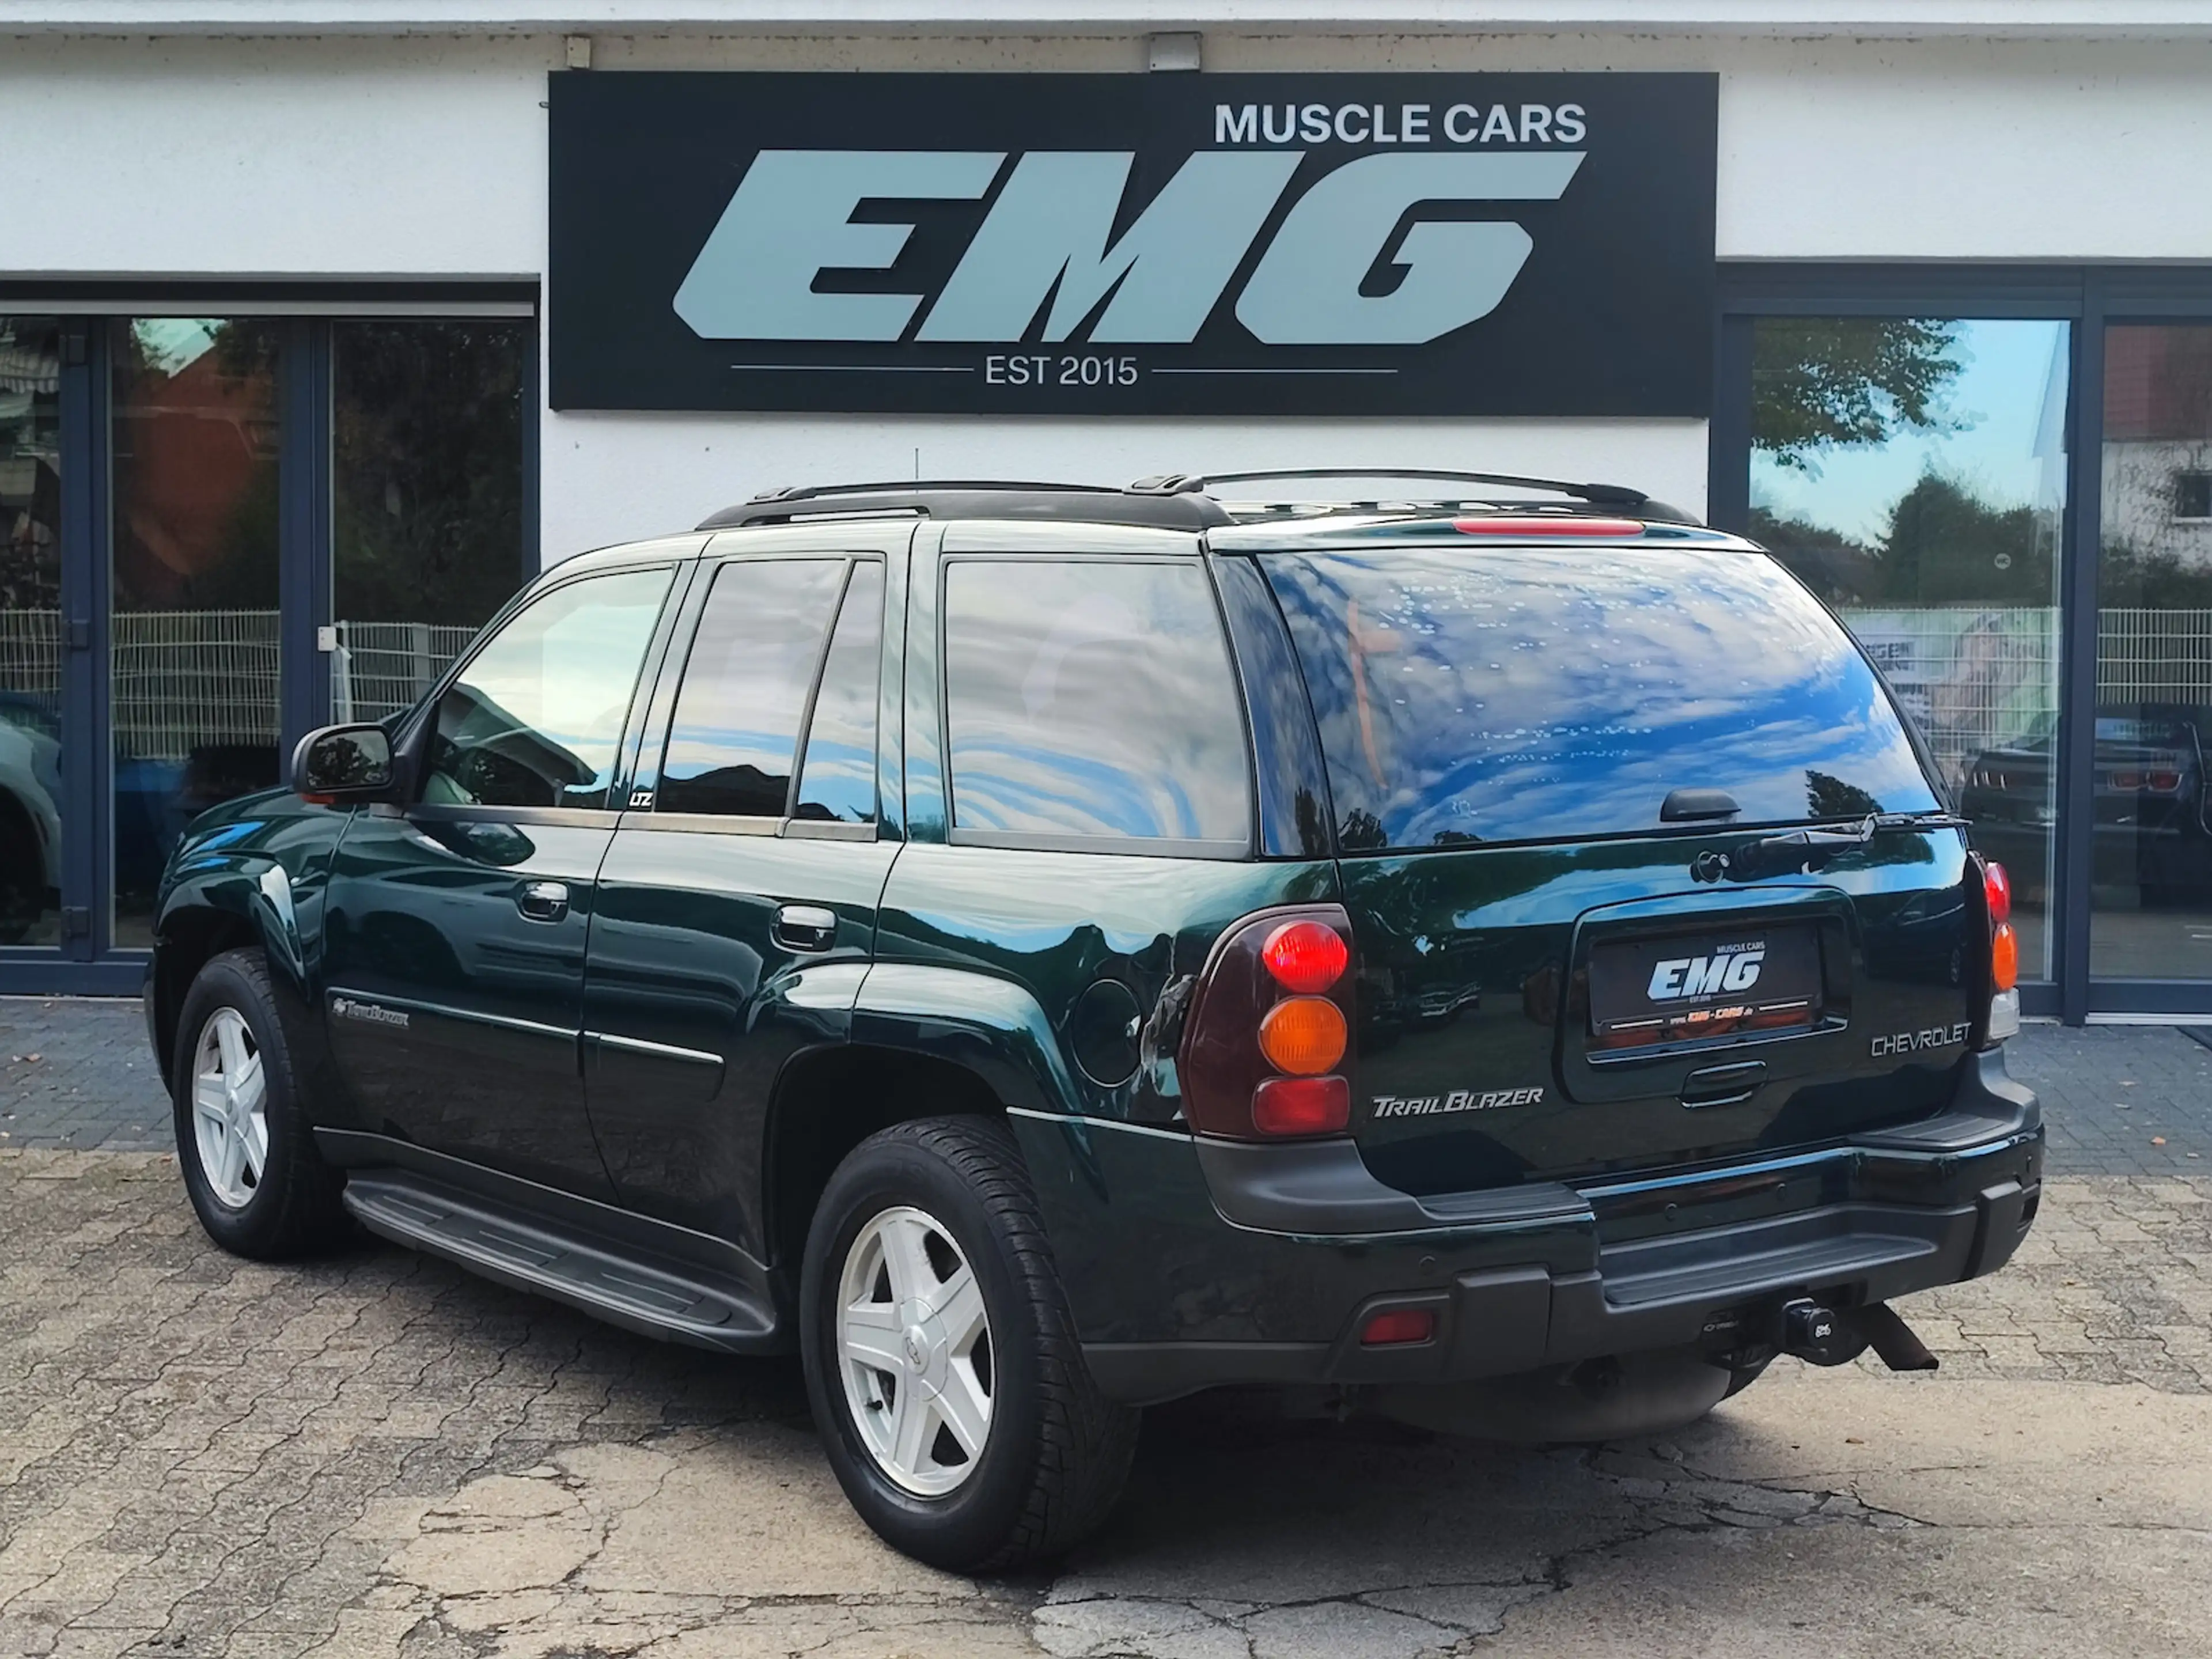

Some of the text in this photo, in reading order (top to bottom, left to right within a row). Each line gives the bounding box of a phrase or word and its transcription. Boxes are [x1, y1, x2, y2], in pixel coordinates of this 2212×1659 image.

[1215, 104, 1587, 143] MUSCLE CARS
[673, 150, 1588, 344] EMG
[986, 355, 1138, 385] EST 2015
[1746, 940, 1766, 951] CARS
[1647, 950, 1765, 1000] EMG
[1871, 1022, 1972, 1056] CHEVROLET
